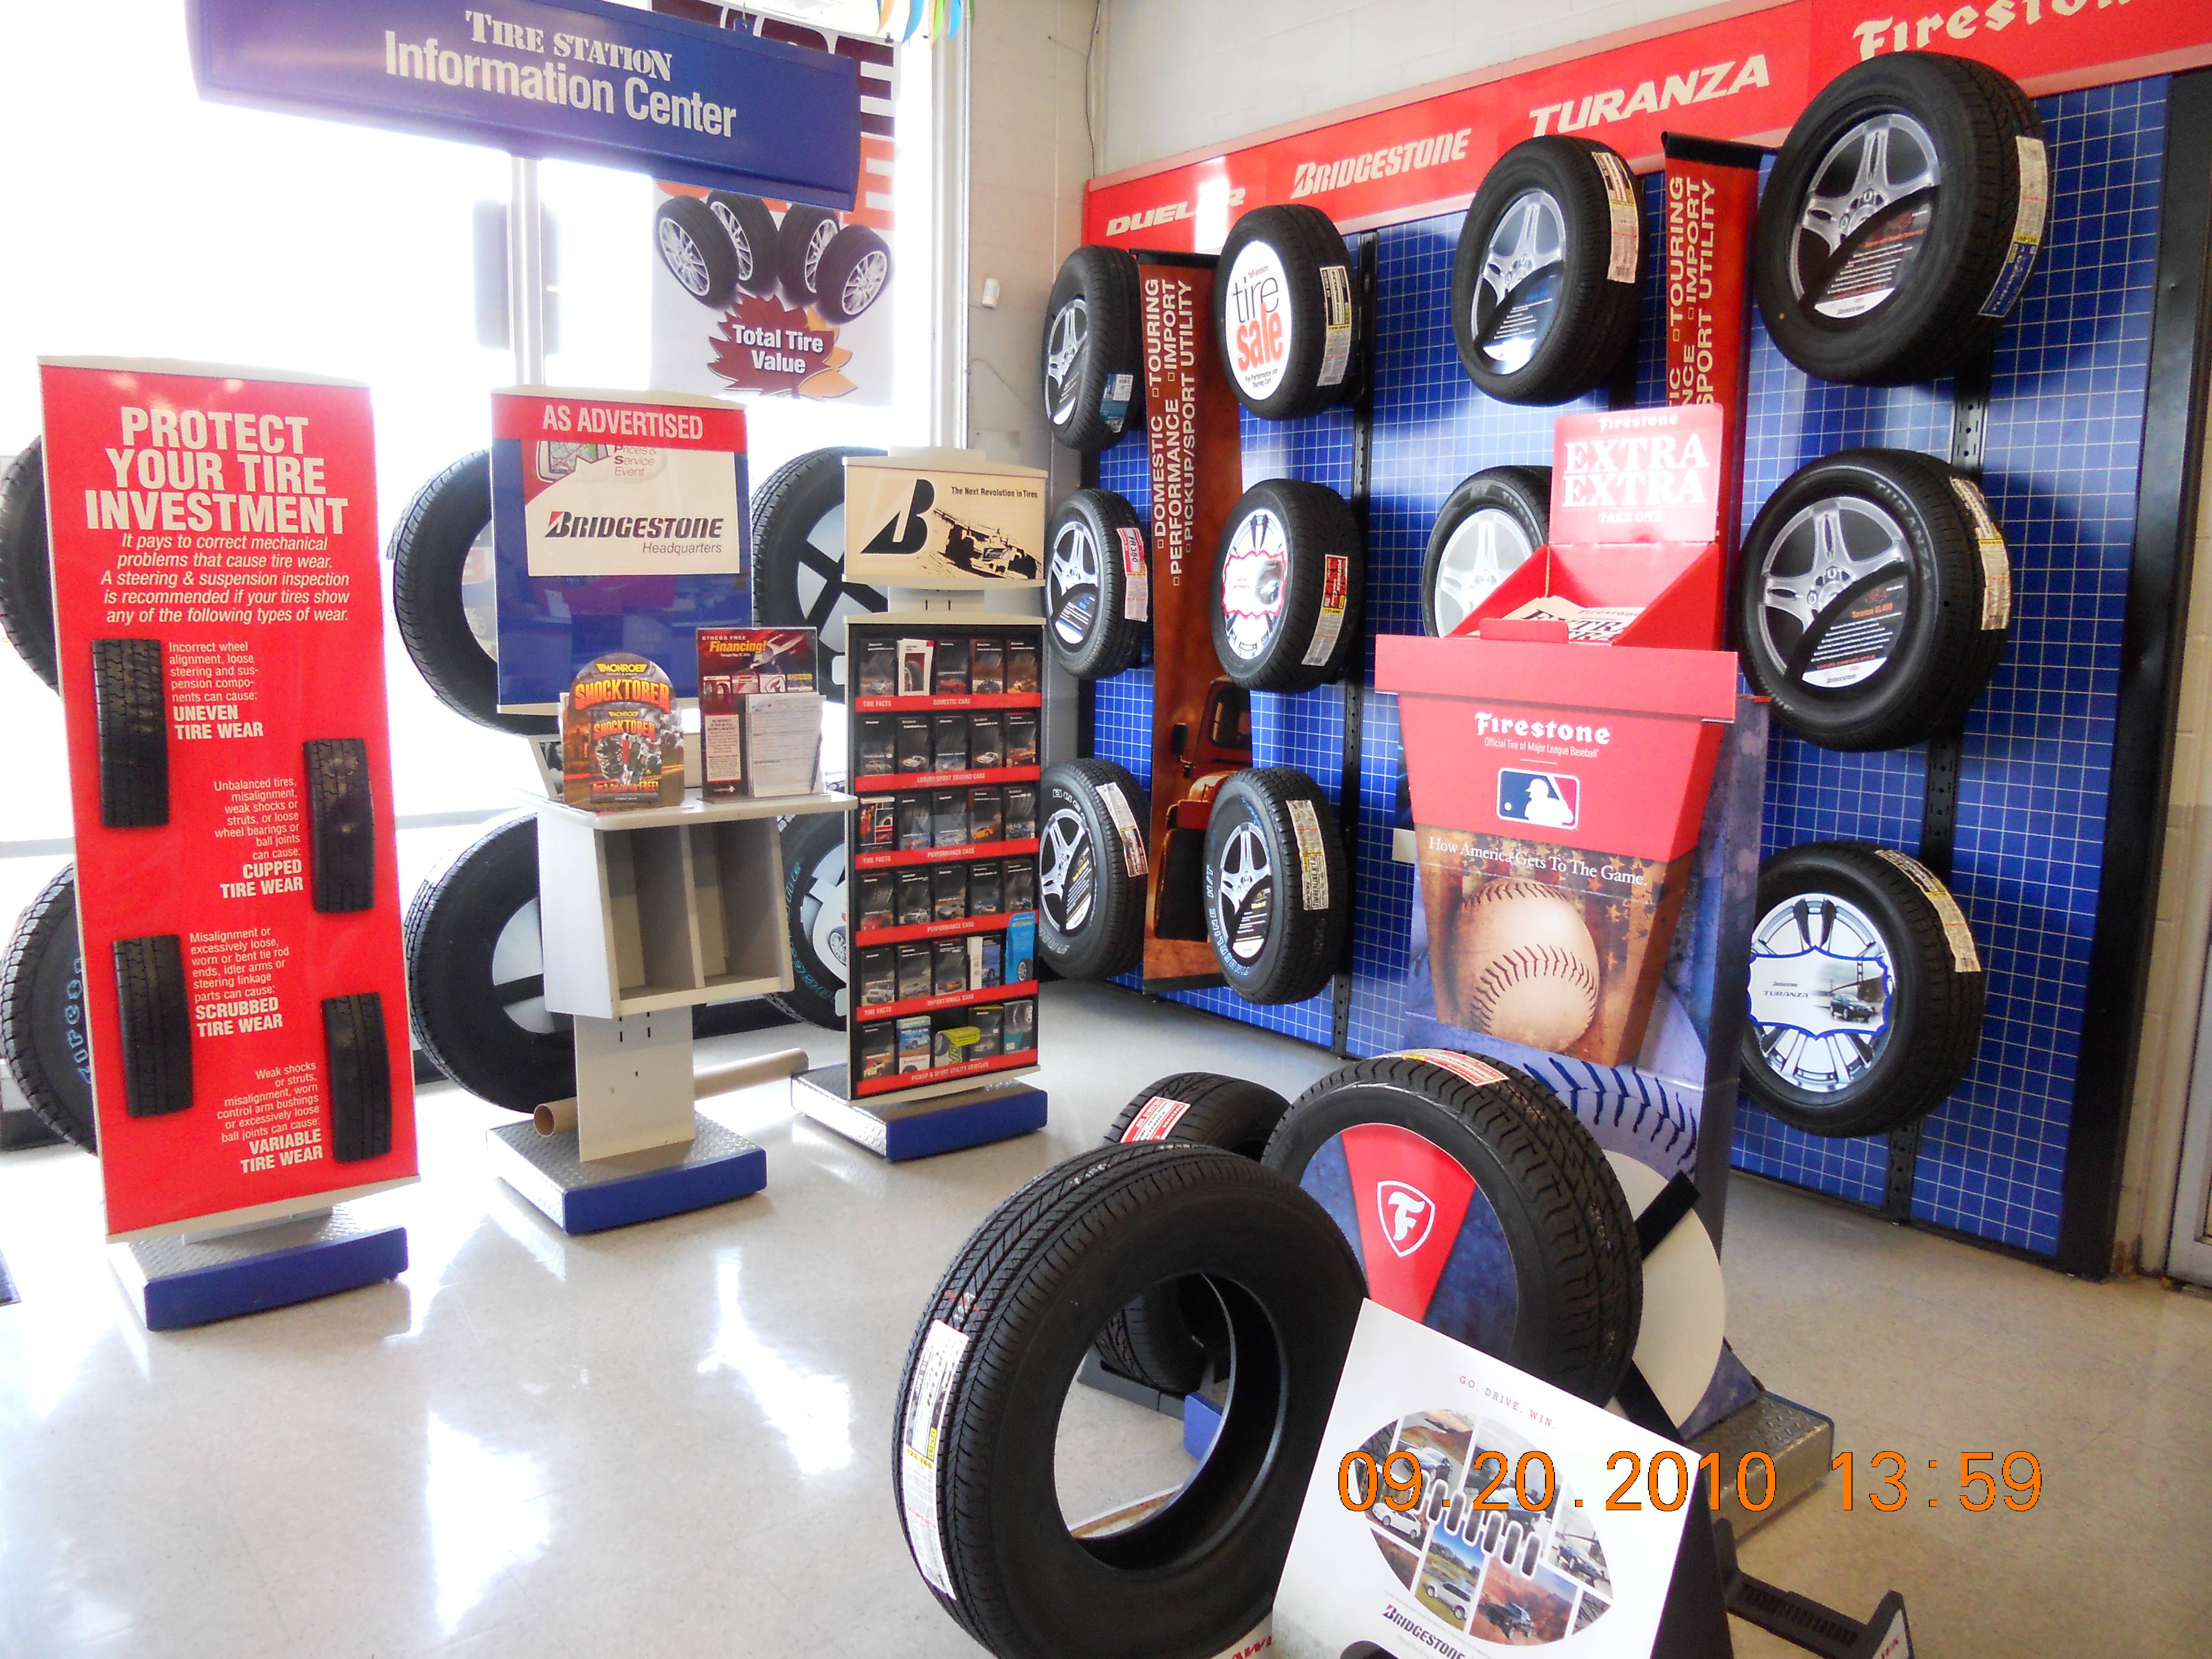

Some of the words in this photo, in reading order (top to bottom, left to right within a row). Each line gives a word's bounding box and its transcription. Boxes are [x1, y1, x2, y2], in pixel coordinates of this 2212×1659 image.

[465, 9, 545, 54] TIRE
[553, 34, 671, 81] STATION
[384, 32, 615, 114] Information
[625, 79, 737, 138] Center
[1528, 55, 1770, 137] TURANZA
[1291, 128, 1472, 199] BRIDGESTONE
[1106, 189, 1245, 237] DUELR
[1670, 177, 1684, 326] TOURING
[1686, 178, 1700, 303] IMPORT
[1699, 180, 1715, 299] UTILITY
[1233, 277, 1279, 323] tire
[1145, 279, 1162, 387] TOURING
[1162, 279, 1177, 369] IMPORT
[1177, 280, 1194, 366] UTILITY
[733, 325, 781, 348] Total
[786, 331, 823, 353] Tire
[1237, 302, 1283, 372] sale
[752, 350, 806, 373] Value
[121, 406, 308, 454] PROTECT
[542, 405, 571, 431] AS
[577, 408, 703, 439] ADVERTISED
[1599, 414, 1678, 431] Firestone
[614, 445, 648, 454] Prices
[614, 456, 655, 466] Service
[1181, 373, 1196, 540] PICKUP/SPORT
[1564, 434, 1709, 475] EXTRA
[106, 448, 225, 490] YOUR
[237, 455, 327, 494] TIRE
[615, 467, 645, 476] Event
[1151, 416, 1166, 536] DOMESTIC
[951, 487, 963, 495] The
[980, 488, 1015, 497] Revolution
[1165, 399, 1182, 574] PERFORMANCE
[1562, 469, 1706, 508] EXTRA
[85, 489, 348, 534] INVESTMENT
[1599, 512, 1632, 523] TAKE
[545, 512, 724, 539] BRIDGESTONE
[122, 533, 133, 549] It
[137, 535, 172, 551] pays
[178, 534, 190, 549] to
[196, 535, 247, 550] correct
[251, 536, 327, 551] mechanical
[643, 541, 722, 556] Headquarters
[117, 552, 187, 570] problems
[193, 553, 222, 567] that
[226, 556, 267, 568] cause
[272, 554, 294, 568] tire
[298, 557, 332, 568] wear.
[101, 572, 111, 586] A
[117, 573, 178, 588] steering
[182, 573, 194, 586] &
[200, 573, 276, 588] suspension
[281, 574, 349, 588] inspection
[104, 591, 117, 604] is
[122, 591, 229, 604] recommended
[233, 590, 243, 604] if
[246, 593, 276, 607] your
[281, 591, 310, 604] tires
[314, 591, 349, 604] show
[106, 611, 134, 625] any
[139, 609, 154, 623] of
[159, 608, 182, 623] the
[187, 608, 252, 624] following
[257, 609, 292, 624] types
[296, 608, 310, 622] of
[314, 610, 348, 622] wear.
[169, 642, 216, 653] Incorrect
[219, 641, 248, 652] wheel
[169, 654, 224, 665] alignment,
[227, 653, 254, 663] loose
[709, 641, 767, 653] Financing!
[599, 664, 647, 672] MONROE
[575, 679, 671, 714] SHOCKTOBER
[174, 705, 238, 721] UNEVEN
[175, 723, 212, 740] TIRE
[217, 722, 263, 739] WEAR
[593, 719, 656, 742] SHOCKTOBER
[1474, 711, 1610, 745] Firestone
[1484, 737, 1506, 748] Official
[1507, 739, 1518, 749] Tire
[1519, 741, 1526, 750] of
[1527, 742, 1547, 753] Major
[1547, 744, 1568, 756] League
[927, 849, 961, 858] PERFORMANCE
[1428, 837, 1458, 852] How
[1460, 842, 1511, 864] America
[1515, 852, 1547, 869] Gets
[1548, 857, 1567, 872] To
[1569, 860, 1598, 877] The
[1600, 865, 1647, 885] Game.
[243, 860, 302, 879] CUPPED
[220, 883, 256, 899] TIRE
[261, 877, 304, 894] WEAR
[1311, 873, 1319, 906] TIMBERLINE
[927, 923, 961, 932] PERFORMANCE
[195, 997, 279, 1020] SCRUBBED
[197, 1022, 234, 1037] TIRE
[239, 1014, 283, 1033] WEAR
[249, 1129, 321, 1155] VARIABLE
[241, 1156, 275, 1173] TIRE
[280, 1146, 323, 1167] WEAR
[1459, 1375, 1479, 1391] GO.
[1485, 1387, 1523, 1414] DRIVE.
[1530, 1410, 1556, 1429] WIN.
